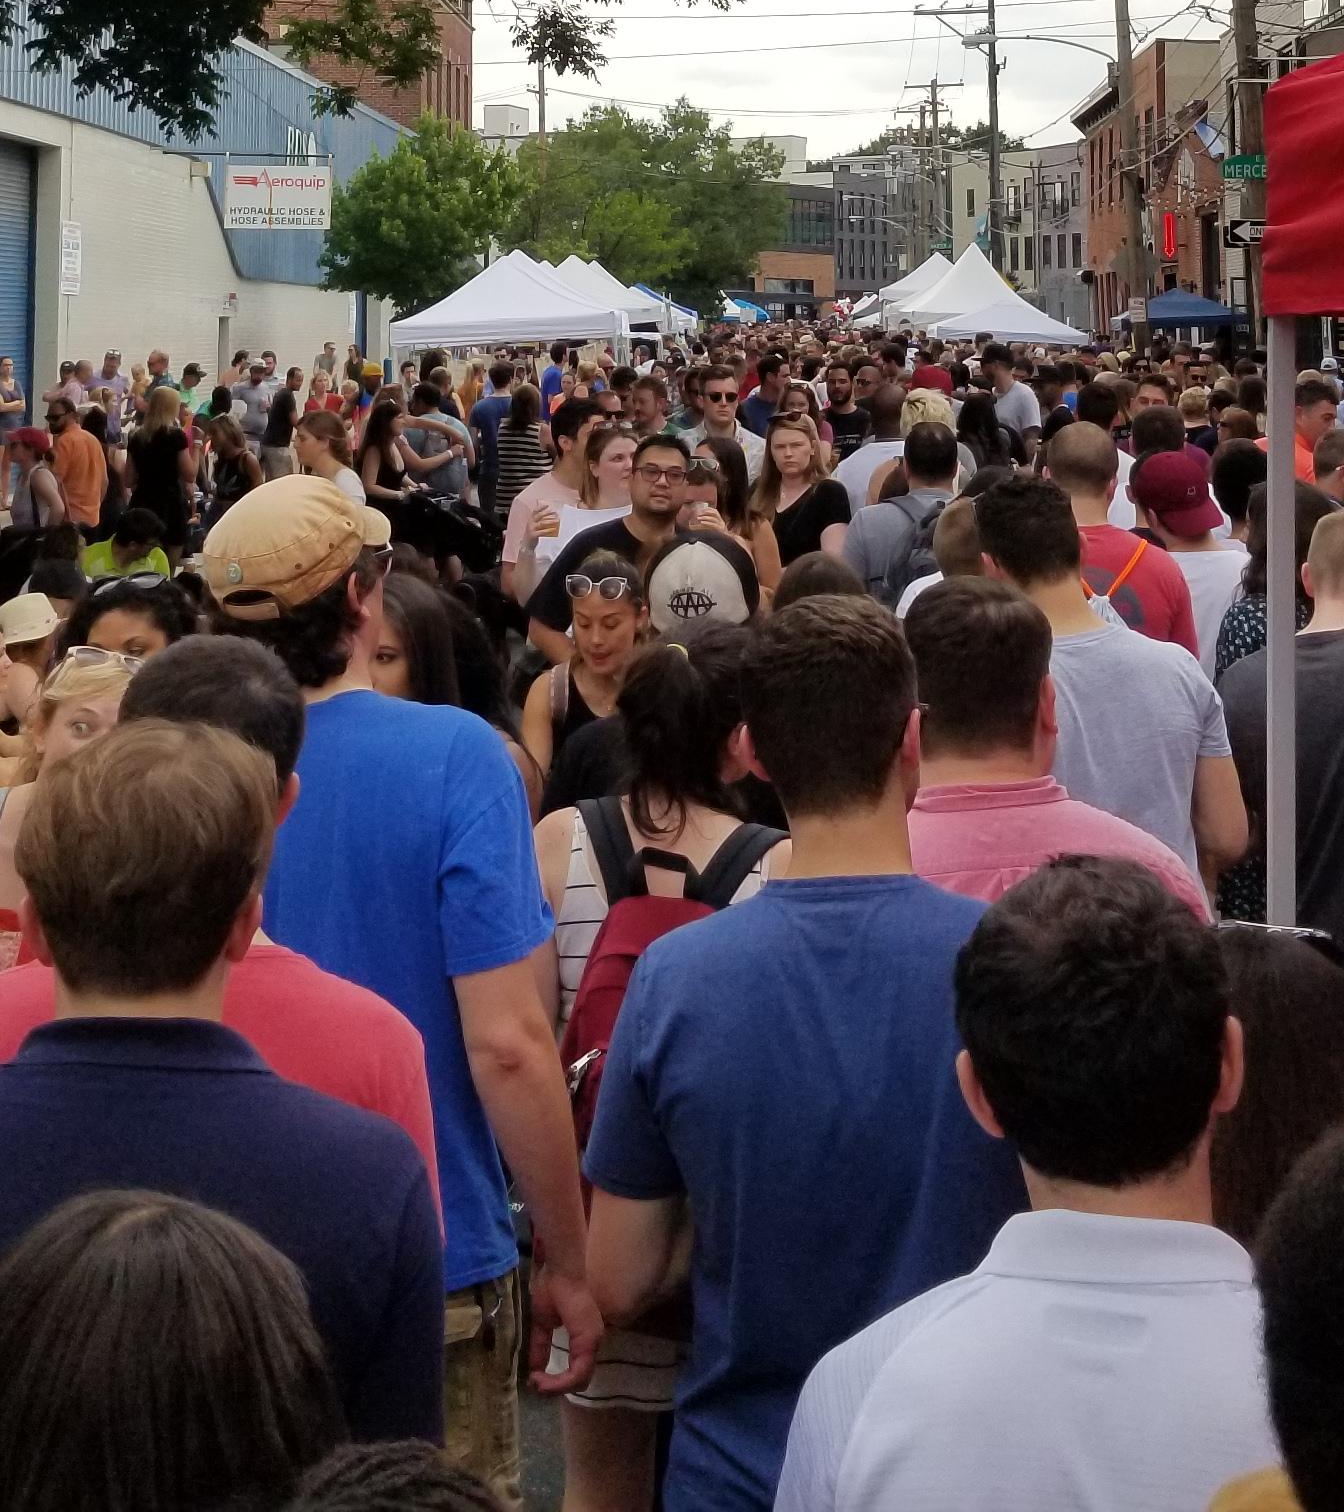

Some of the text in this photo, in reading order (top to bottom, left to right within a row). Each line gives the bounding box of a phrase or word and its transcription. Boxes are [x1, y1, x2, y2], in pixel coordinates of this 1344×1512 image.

[258, 168, 326, 190] Aeroquip
[229, 207, 325, 216] HYDRAULIC HOSE &
[231, 216, 324, 225] HOSE ASSEMBLIES
